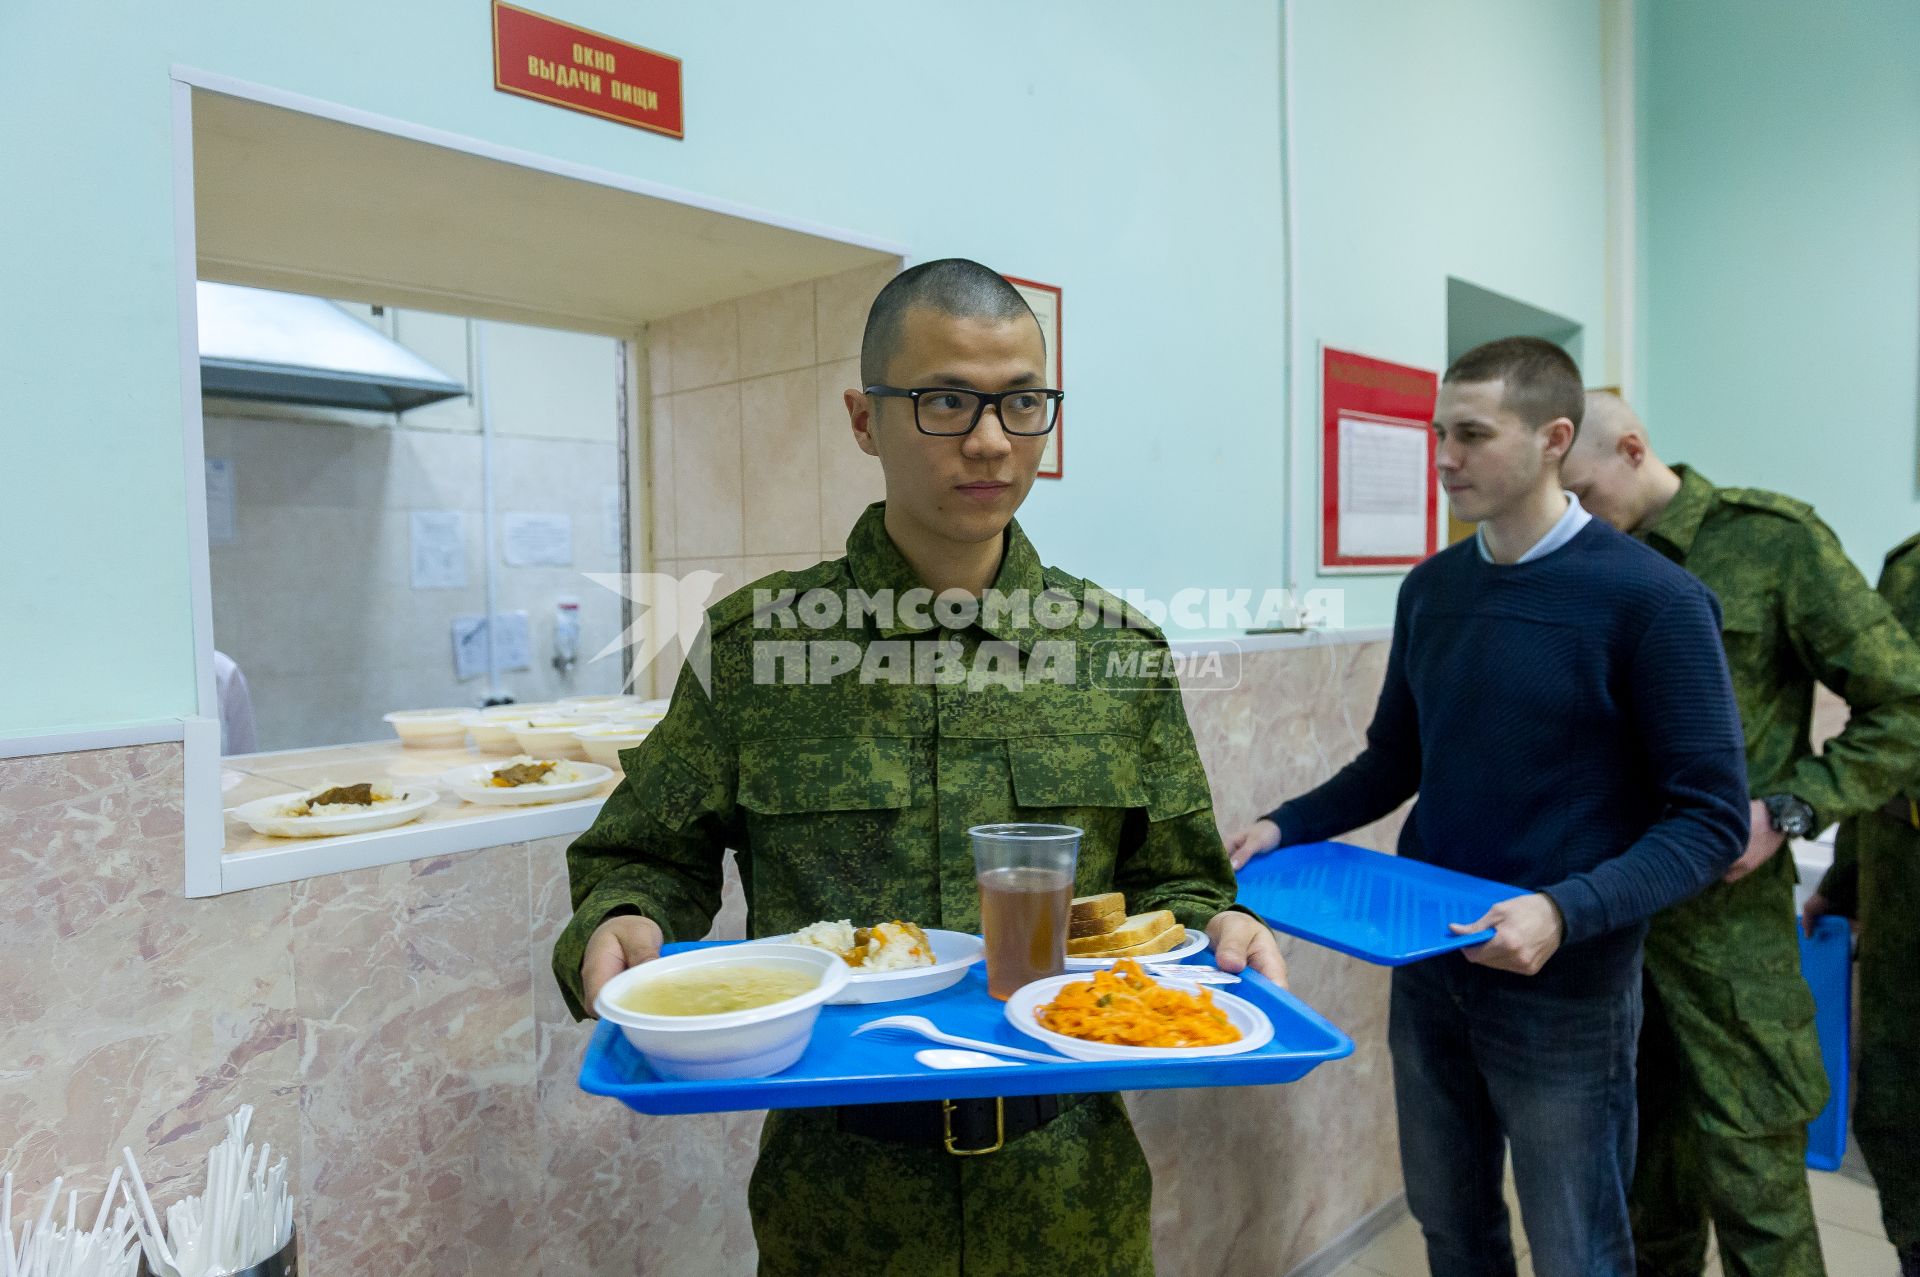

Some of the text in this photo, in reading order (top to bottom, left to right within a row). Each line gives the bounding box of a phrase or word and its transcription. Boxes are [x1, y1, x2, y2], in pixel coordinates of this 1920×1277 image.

[573, 43, 616, 74] ОКНО
[527, 55, 658, 111] ВЫДАЧИ ПИЩИ
